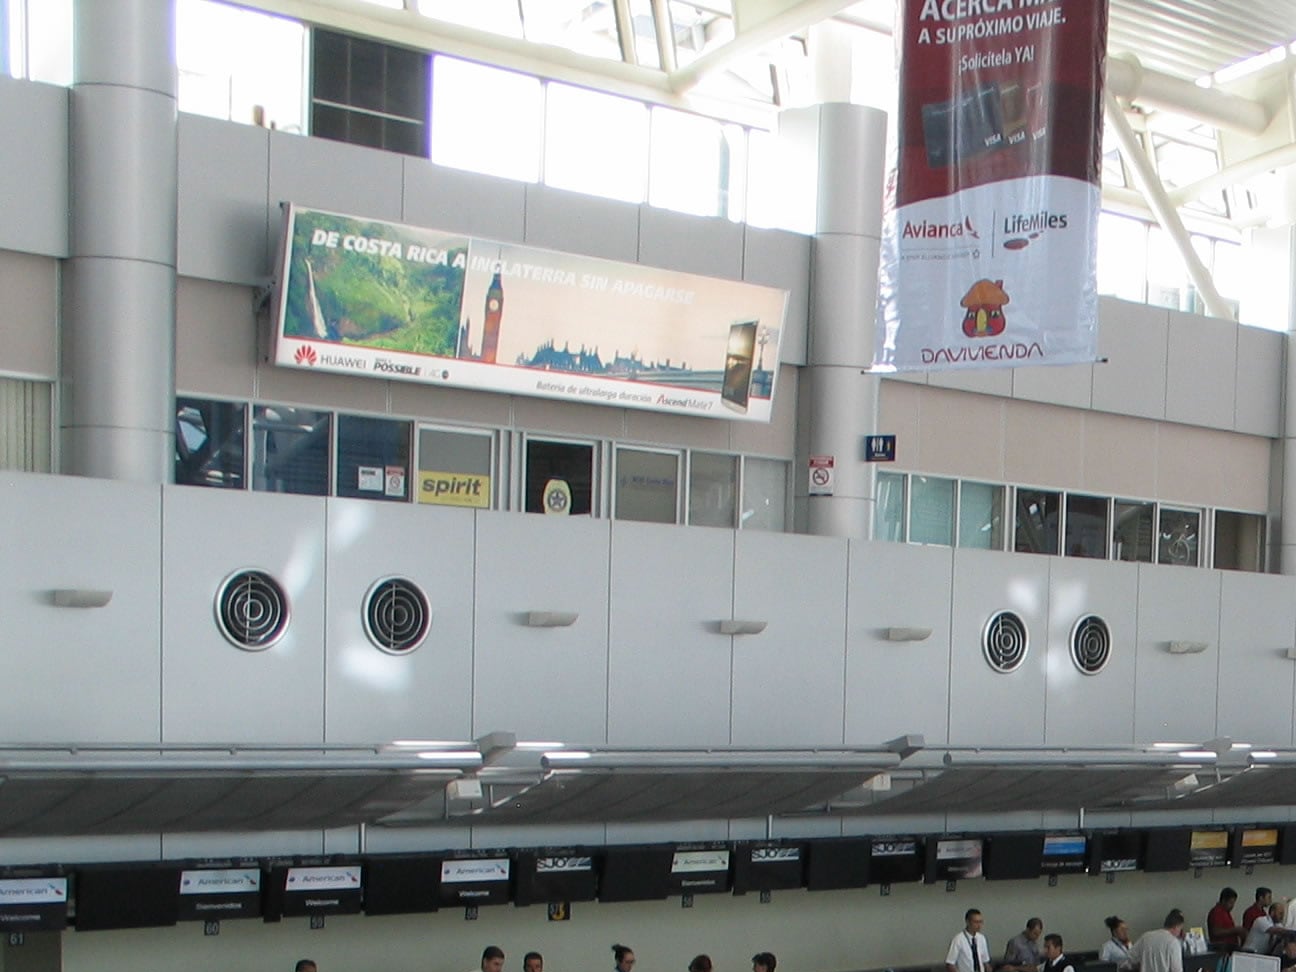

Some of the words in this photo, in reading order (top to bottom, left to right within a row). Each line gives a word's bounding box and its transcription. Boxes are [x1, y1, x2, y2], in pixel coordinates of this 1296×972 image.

[918, 28, 931, 44] A
[935, 28, 956, 45] SU
[957, 16, 1024, 42] PRÓXIMO
[1026, 7, 1067, 30] VIAJE.
[959, 49, 1012, 76] ¡Solicítela
[1014, 44, 1035, 63] YA!
[902, 219, 964, 240] Avianca
[1003, 211, 1068, 235] LifeMiles
[312, 229, 340, 248] DE
[343, 234, 402, 259] COSTA
[407, 245, 448, 265] RICA
[452, 253, 466, 269] A
[471, 255, 577, 287] INGLATERRA
[580, 273, 609, 292] SIN
[613, 278, 697, 305] APAGARSE
[320, 355, 367, 370] HUAWEI
[373, 362, 422, 377] POSSIBLE
[920, 342, 1043, 364] DAVIVIENDA
[422, 477, 482, 497] spirit
